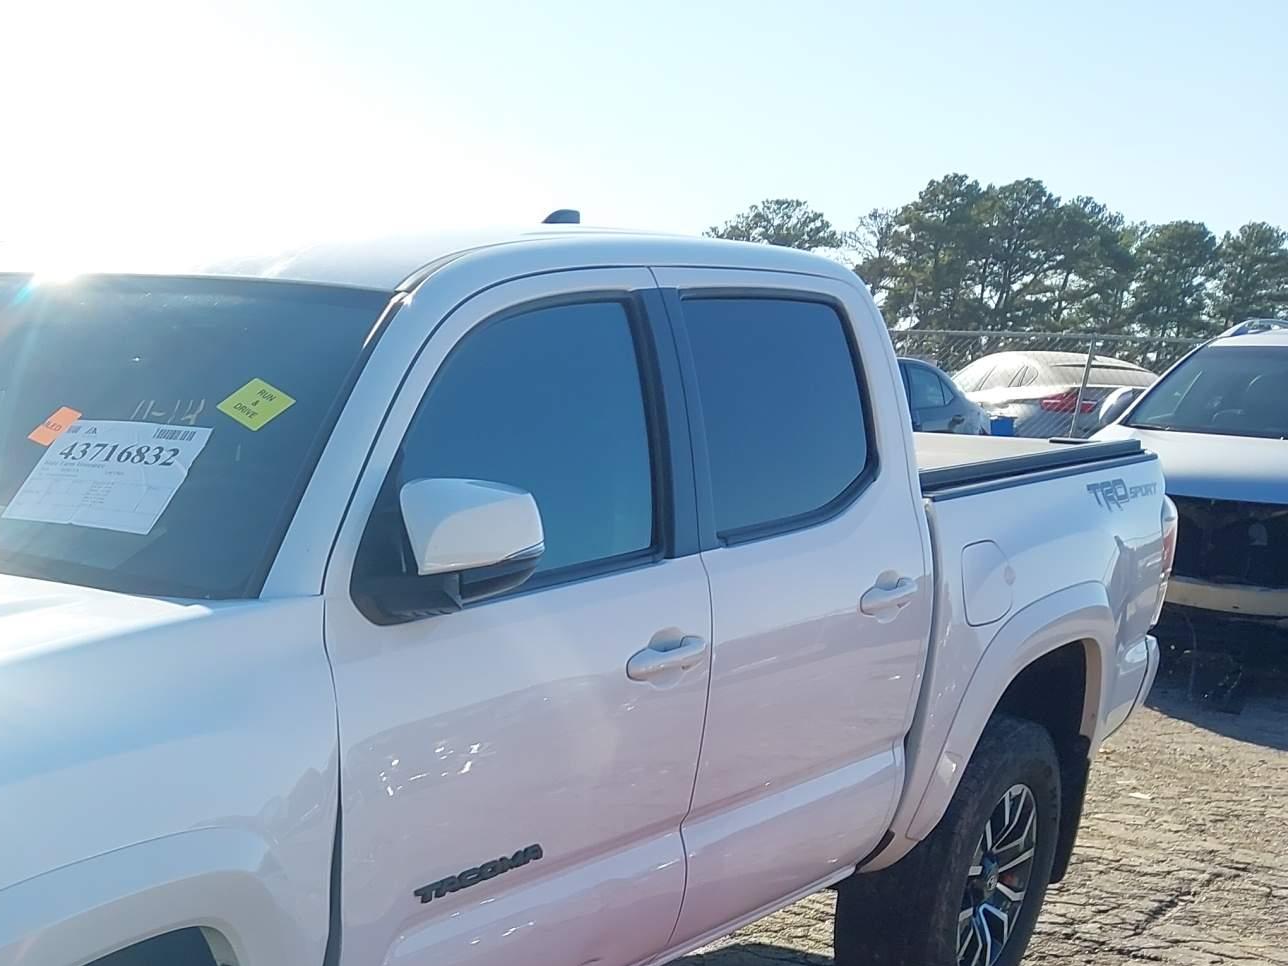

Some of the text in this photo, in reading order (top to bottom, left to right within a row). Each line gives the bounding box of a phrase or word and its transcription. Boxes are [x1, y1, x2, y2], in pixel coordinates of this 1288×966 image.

[257, 389, 277, 402] RUN
[233, 402, 258, 419] DRIVE
[59, 441, 180, 467] 43716832
[1086, 478, 1158, 512] TRD SPORT
[413, 843, 544, 904] TACOMA
